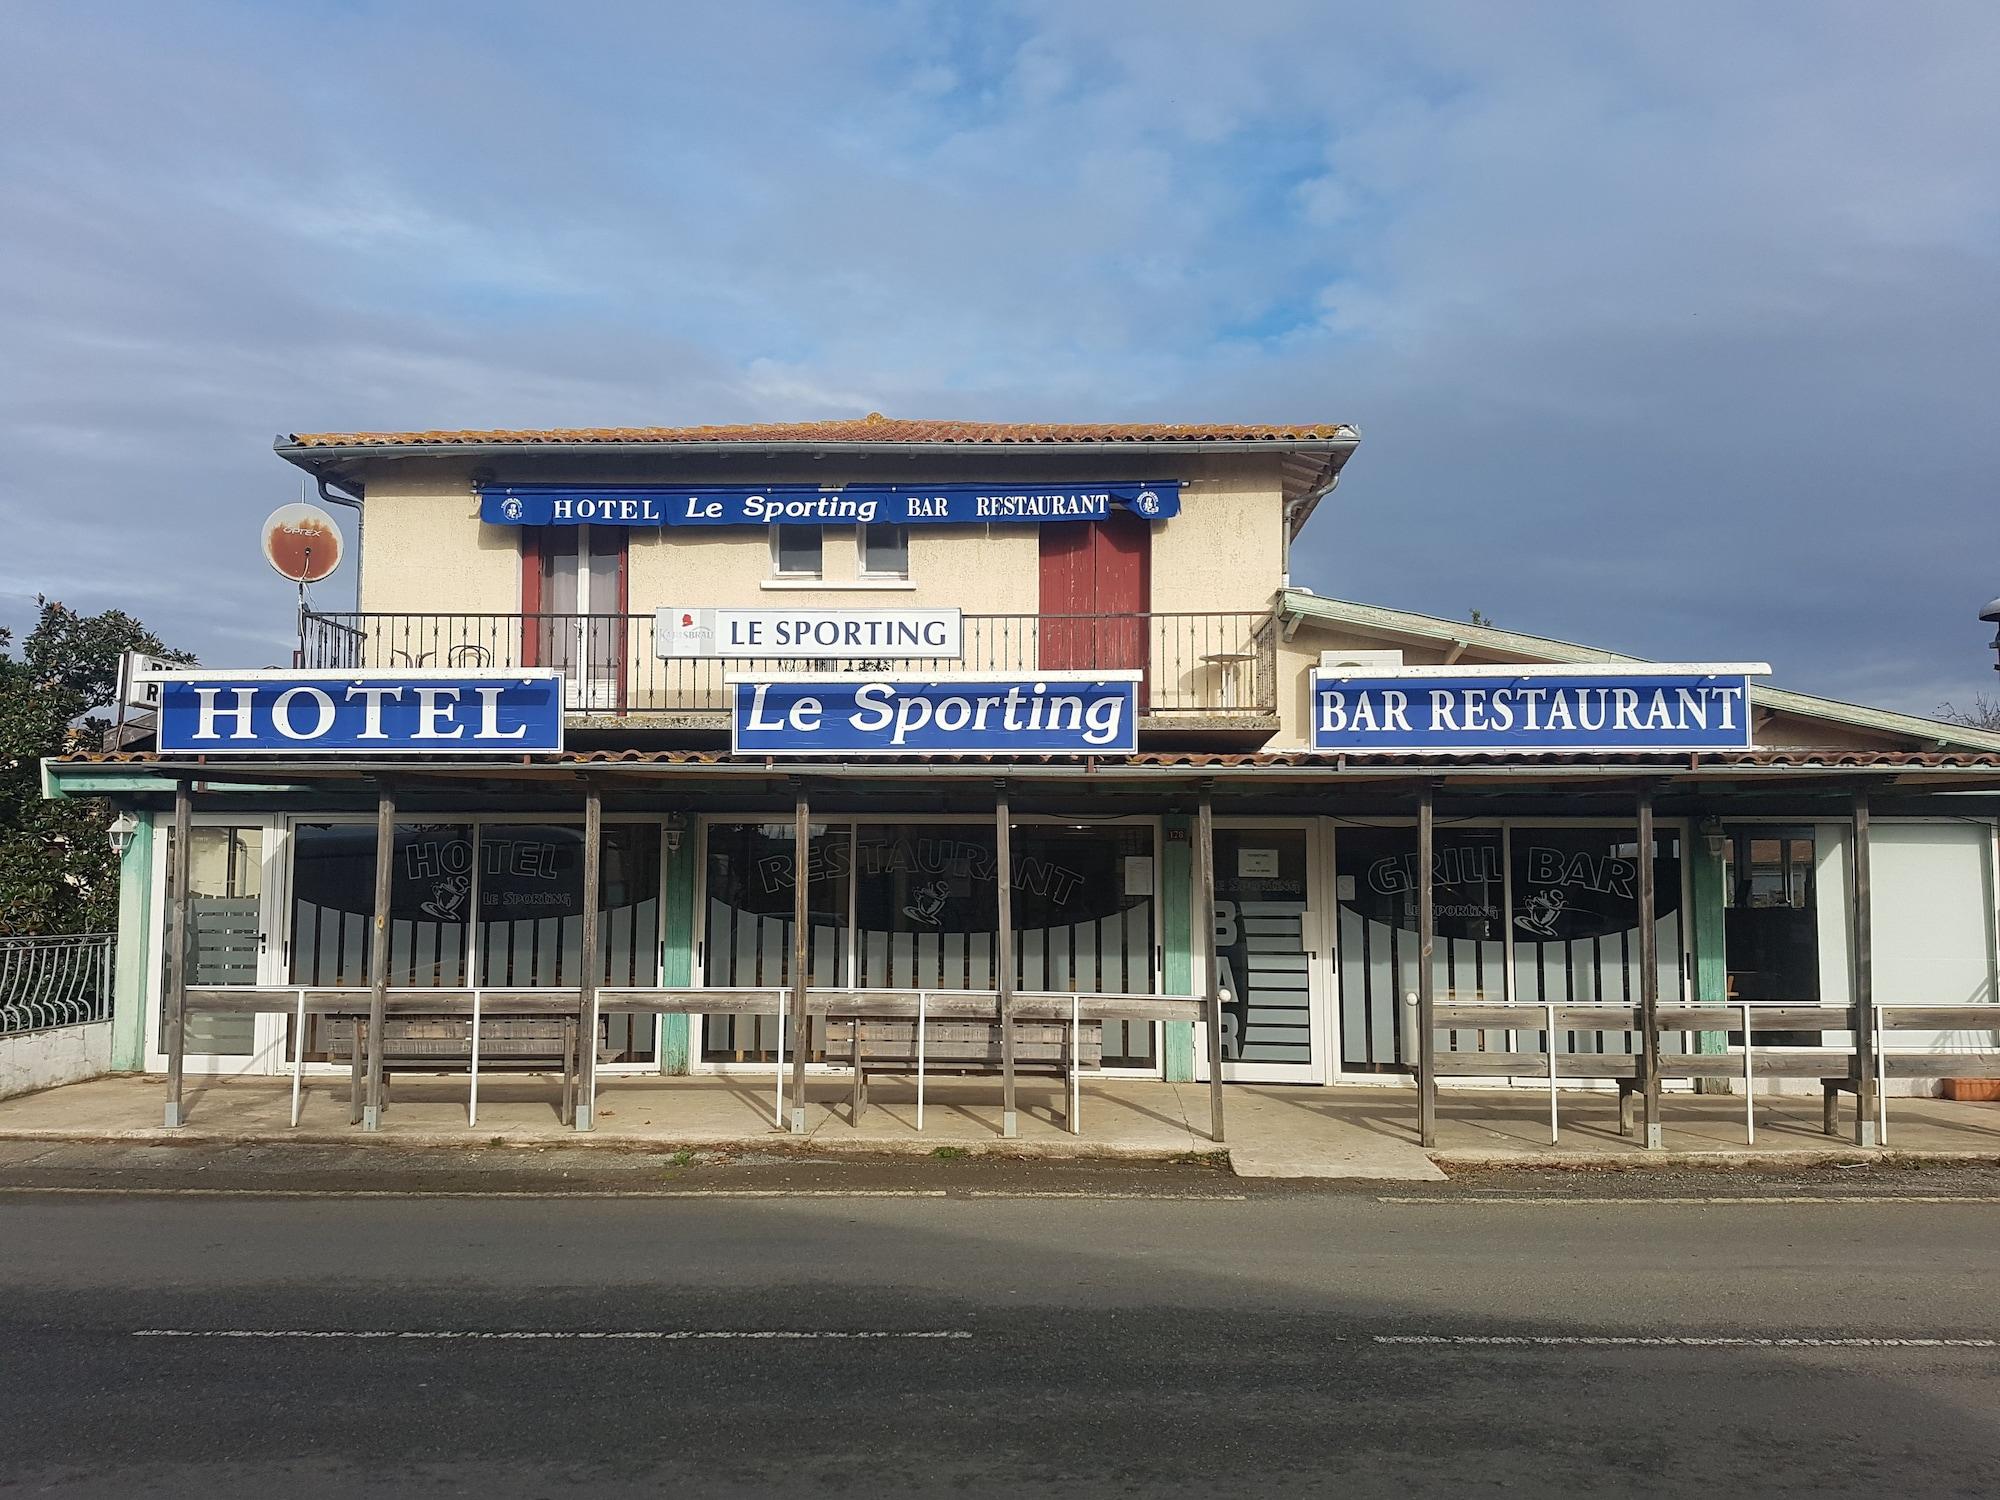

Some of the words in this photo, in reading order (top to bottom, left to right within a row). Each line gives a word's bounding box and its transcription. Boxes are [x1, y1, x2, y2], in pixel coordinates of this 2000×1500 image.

[282, 526, 323, 537] OPTEX
[553, 499, 660, 520] HOTEL
[685, 497, 723, 518] Le
[742, 495, 878, 523] Sporting
[906, 497, 949, 517] BAR
[975, 494, 1109, 517] RESTAURANT
[731, 621, 762, 645] LE
[776, 620, 946, 646] SPORTING
[191, 687, 527, 740] HOTEL
[745, 684, 823, 732] Le
[848, 683, 1125, 745] Sporting
[1319, 690, 1414, 732] BAR
[1428, 686, 1742, 732] RESTAURANT
[406, 839, 558, 880] HOTEL
[758, 837, 1085, 906] RESTAURANT
[1367, 846, 1504, 895] GRILL
[1528, 847, 1637, 899] BAR
[1215, 900, 1240, 1060] BAR
